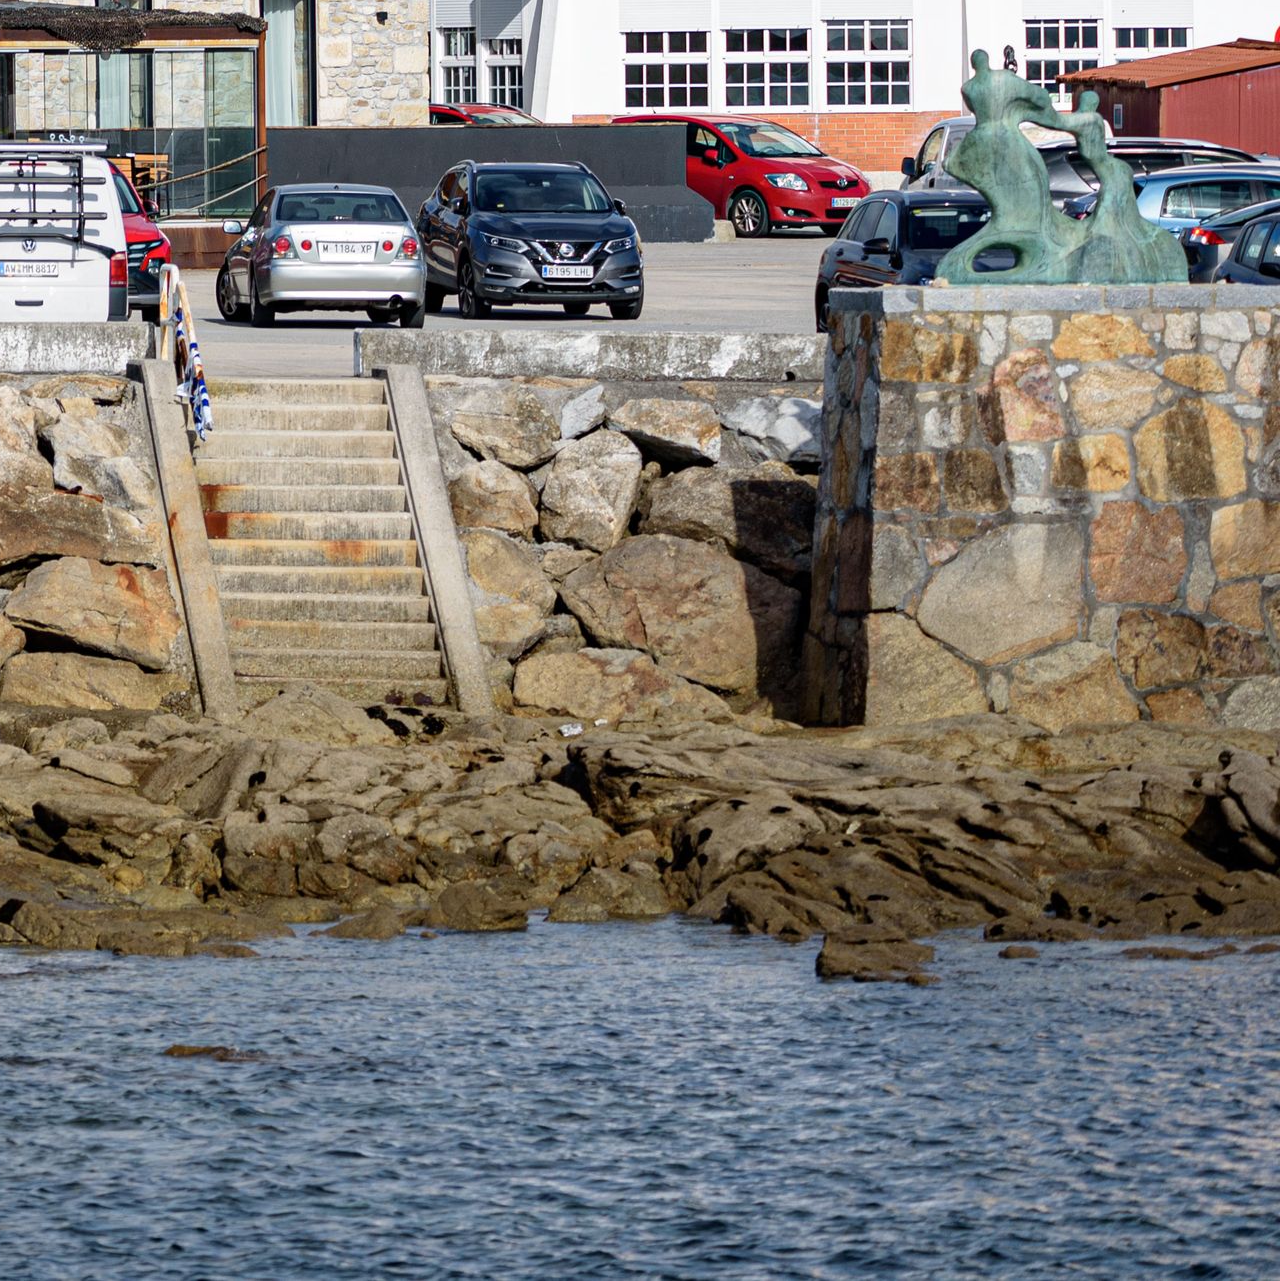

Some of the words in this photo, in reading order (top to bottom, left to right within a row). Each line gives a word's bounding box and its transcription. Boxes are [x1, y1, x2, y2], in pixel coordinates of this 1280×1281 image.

[322, 244, 329, 253] M
[334, 244, 356, 253] 1184
[360, 244, 372, 253] XP
[35, 264, 57, 273] 8817
[548, 267, 571, 276] 6195
